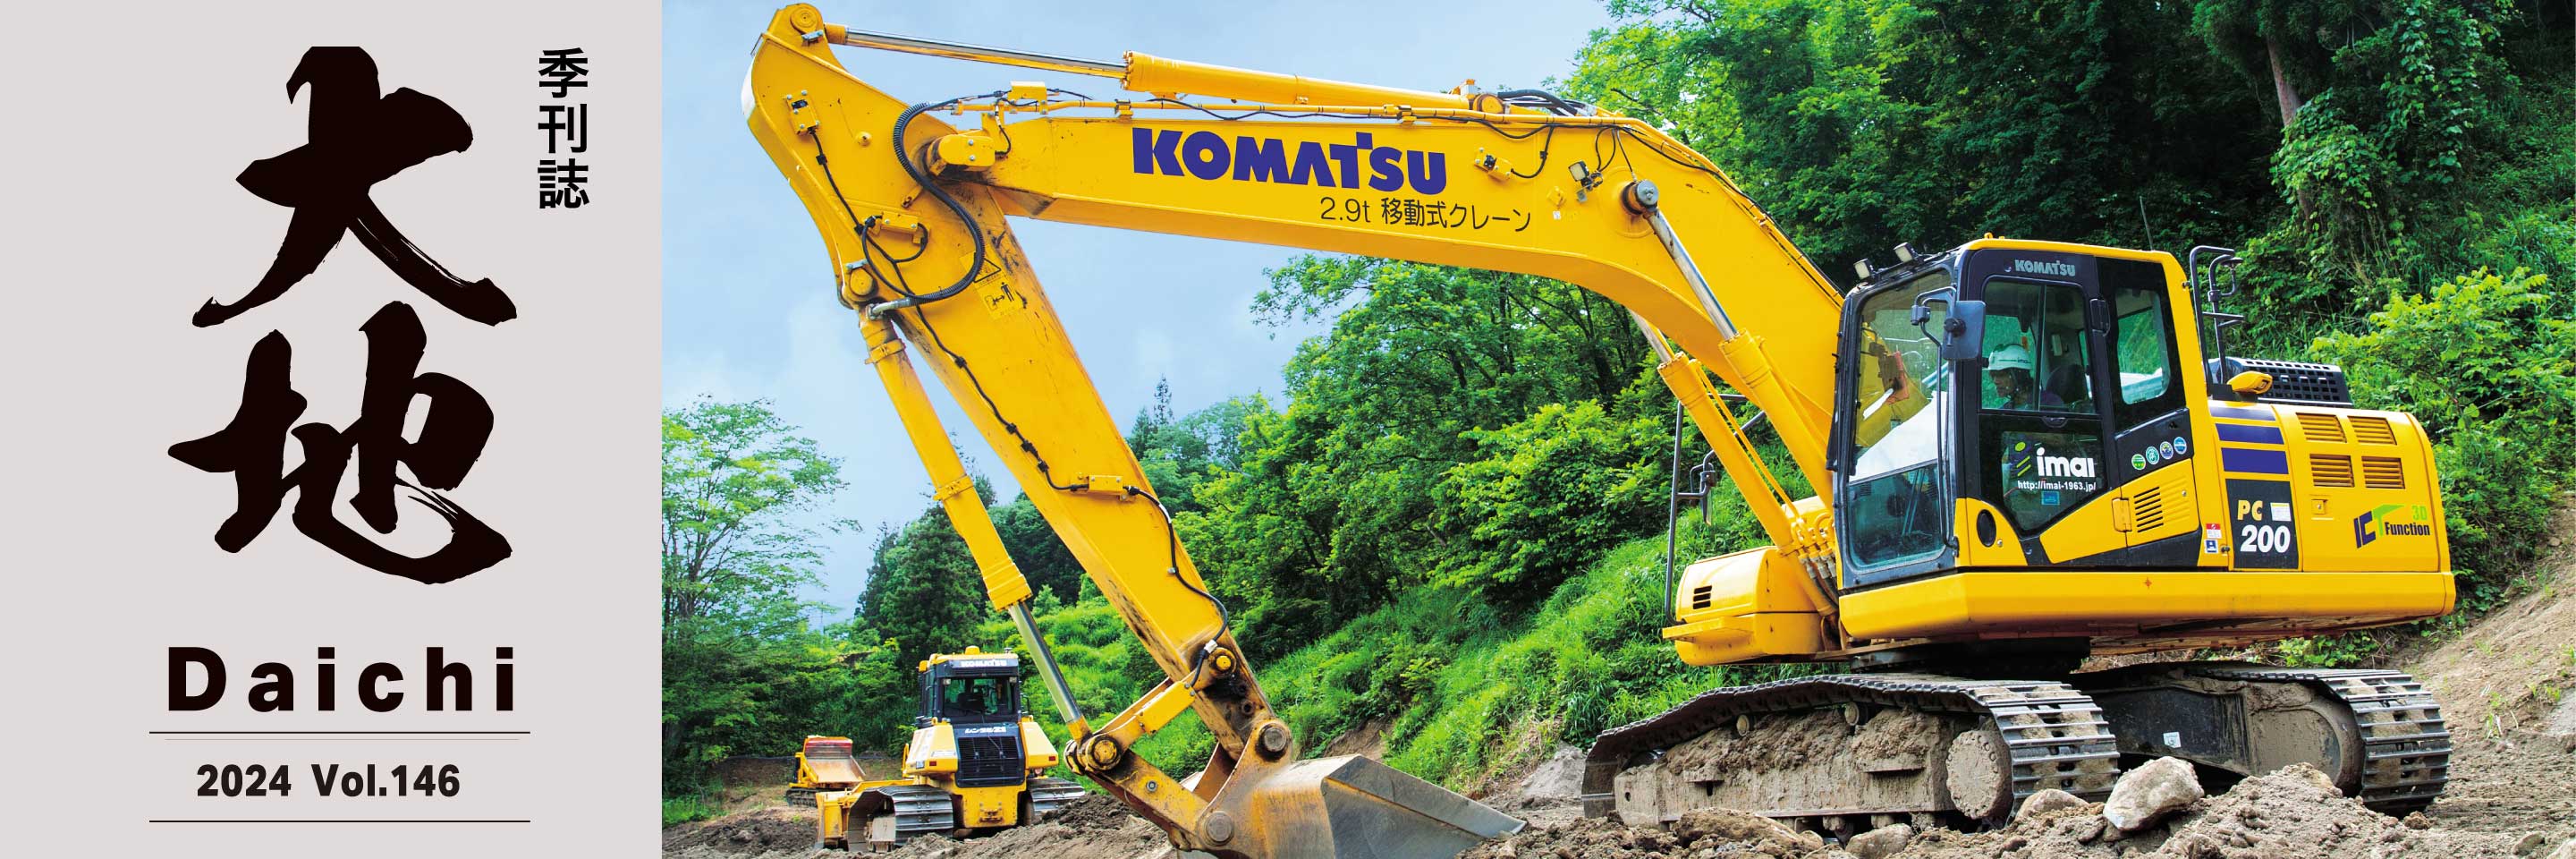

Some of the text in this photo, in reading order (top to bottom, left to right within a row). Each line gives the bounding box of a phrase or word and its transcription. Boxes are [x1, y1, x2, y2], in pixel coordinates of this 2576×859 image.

[1132, 127, 1446, 195] KOMATSU
[1320, 197, 1530, 232] 2.9t 移動式クレーン
[2014, 259, 2076, 276] KOMATSU
[2037, 447, 2096, 477] imai
[2017, 481, 2096, 492] http://imai-1963.jp/
[2237, 499, 2263, 521] PC
[2411, 506, 2428, 521] 3D
[2240, 524, 2291, 553] 200
[2353, 504, 2405, 549] ICT
[2385, 522, 2431, 536] Function
